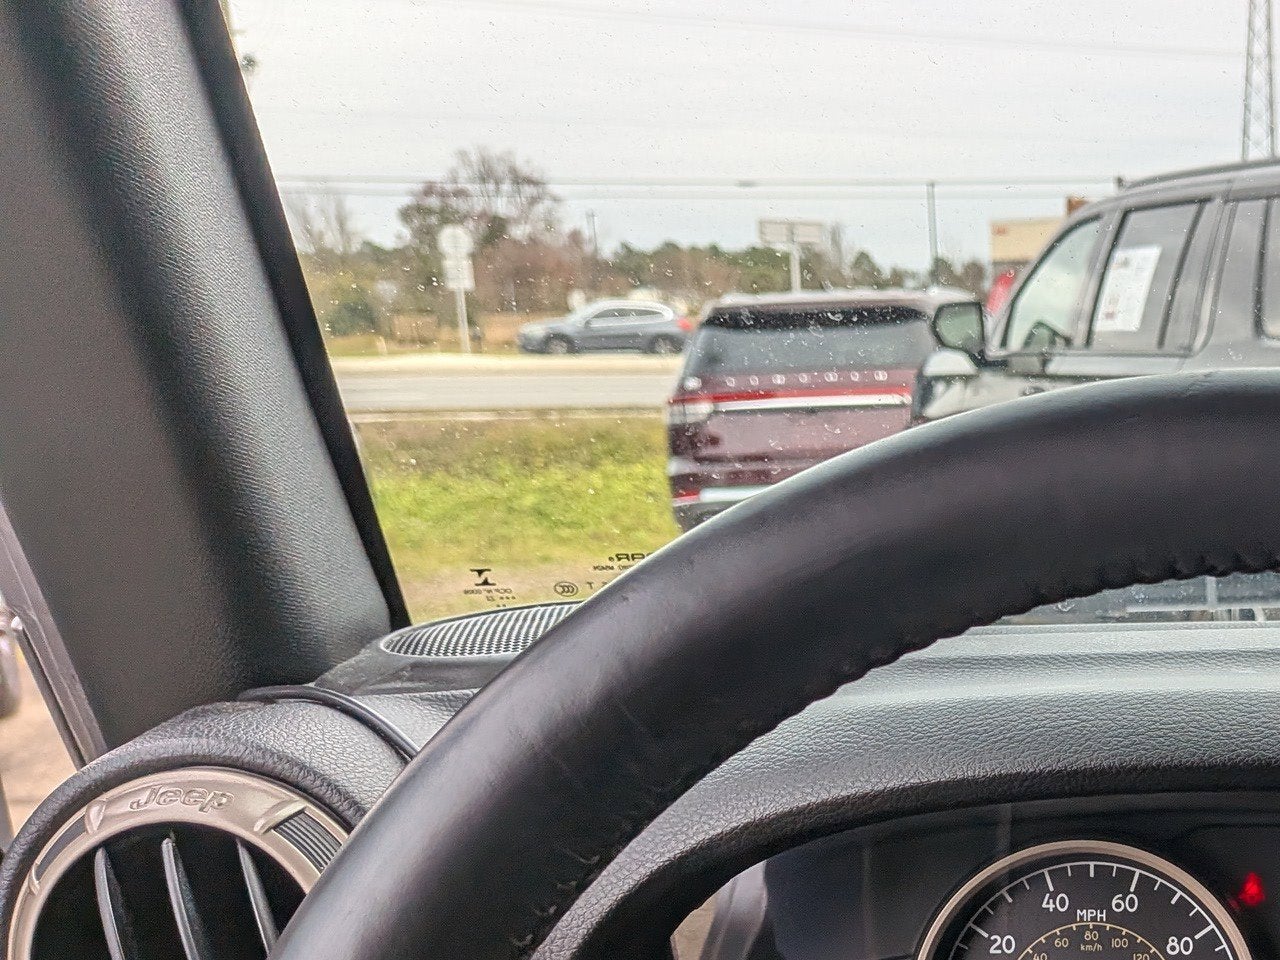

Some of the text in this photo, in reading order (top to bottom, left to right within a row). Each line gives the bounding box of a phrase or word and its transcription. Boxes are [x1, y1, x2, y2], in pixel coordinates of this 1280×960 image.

[129, 785, 235, 813] Jeep
[1041, 893, 1070, 912] 40
[1111, 893, 1139, 913] 60
[1076, 909, 1107, 922] MPH
[1054, 937, 1069, 948] 60
[1084, 930, 1099, 941] 80
[1111, 938, 1129, 948] 100
[989, 934, 1016, 954] 20
[1080, 942, 1103, 952] km/h
[1166, 936, 1194, 956] 80
